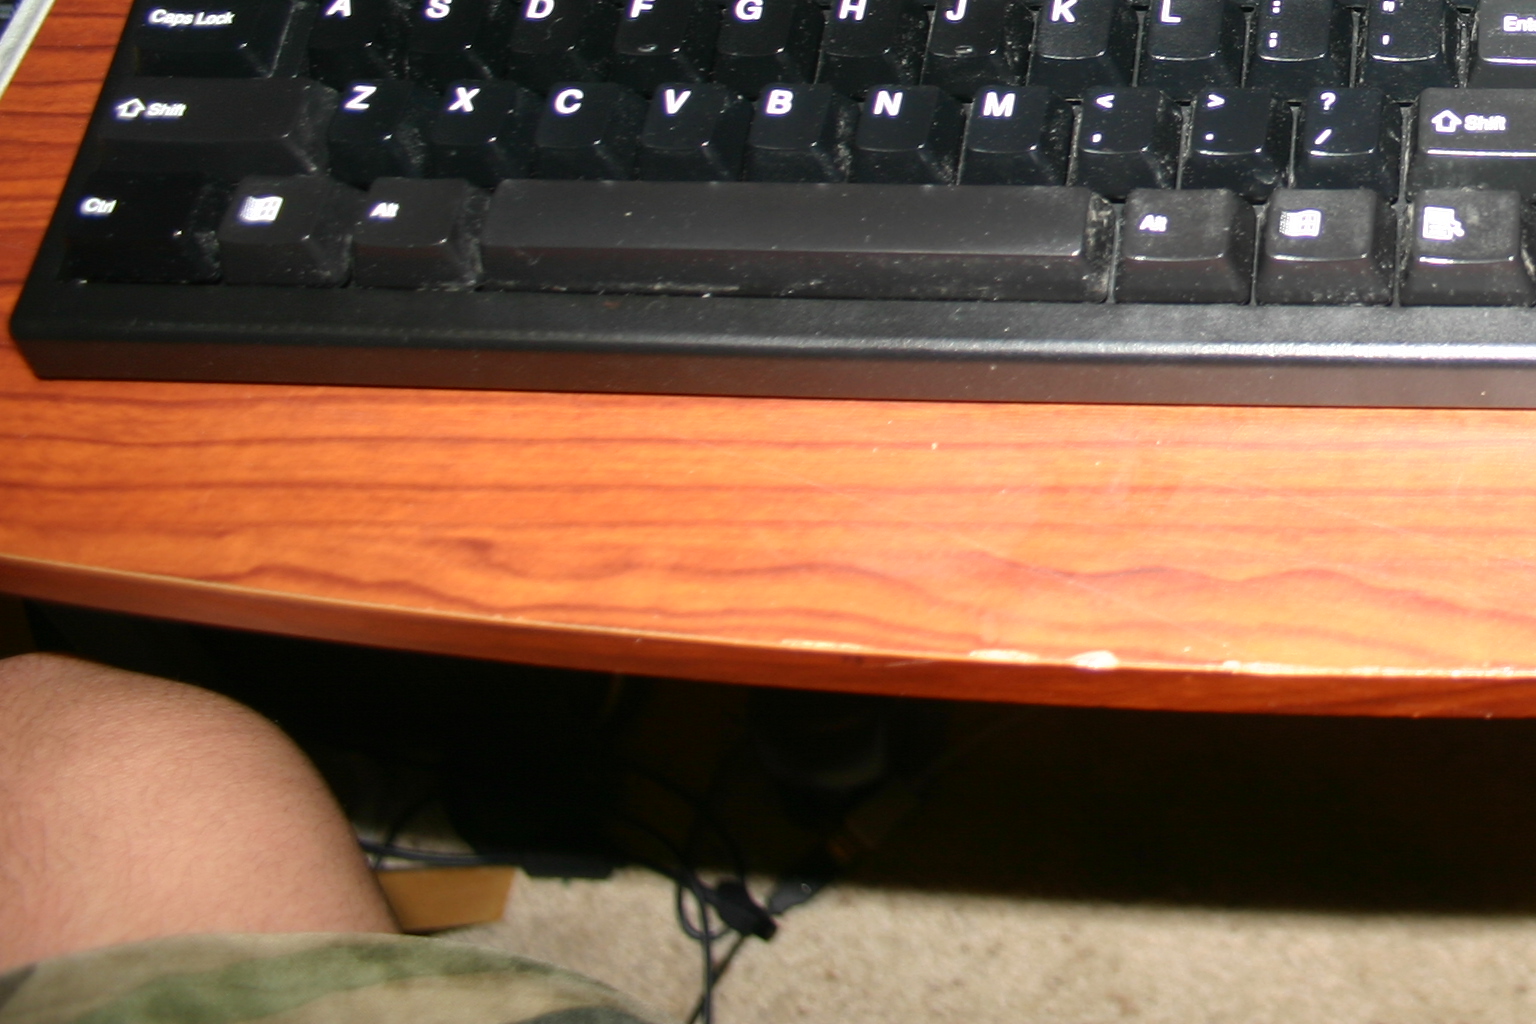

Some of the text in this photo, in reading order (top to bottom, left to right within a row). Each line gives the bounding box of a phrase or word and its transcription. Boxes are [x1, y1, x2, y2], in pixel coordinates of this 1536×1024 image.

[148, 8, 236, 27] Caps Lock
[344, 84, 377, 111] Z
[448, 86, 481, 113] X
[554, 88, 584, 115] C
[664, 88, 692, 115] V
[765, 88, 794, 115] B
[872, 90, 904, 117] N
[982, 91, 1016, 118] M
[1320, 91, 1337, 111] ?
[146, 102, 187, 118] Shift
[1462, 114, 1508, 134] Shift
[80, 197, 117, 215] Ctrl
[369, 202, 400, 219] Alt
[1138, 214, 1168, 233] Alt
